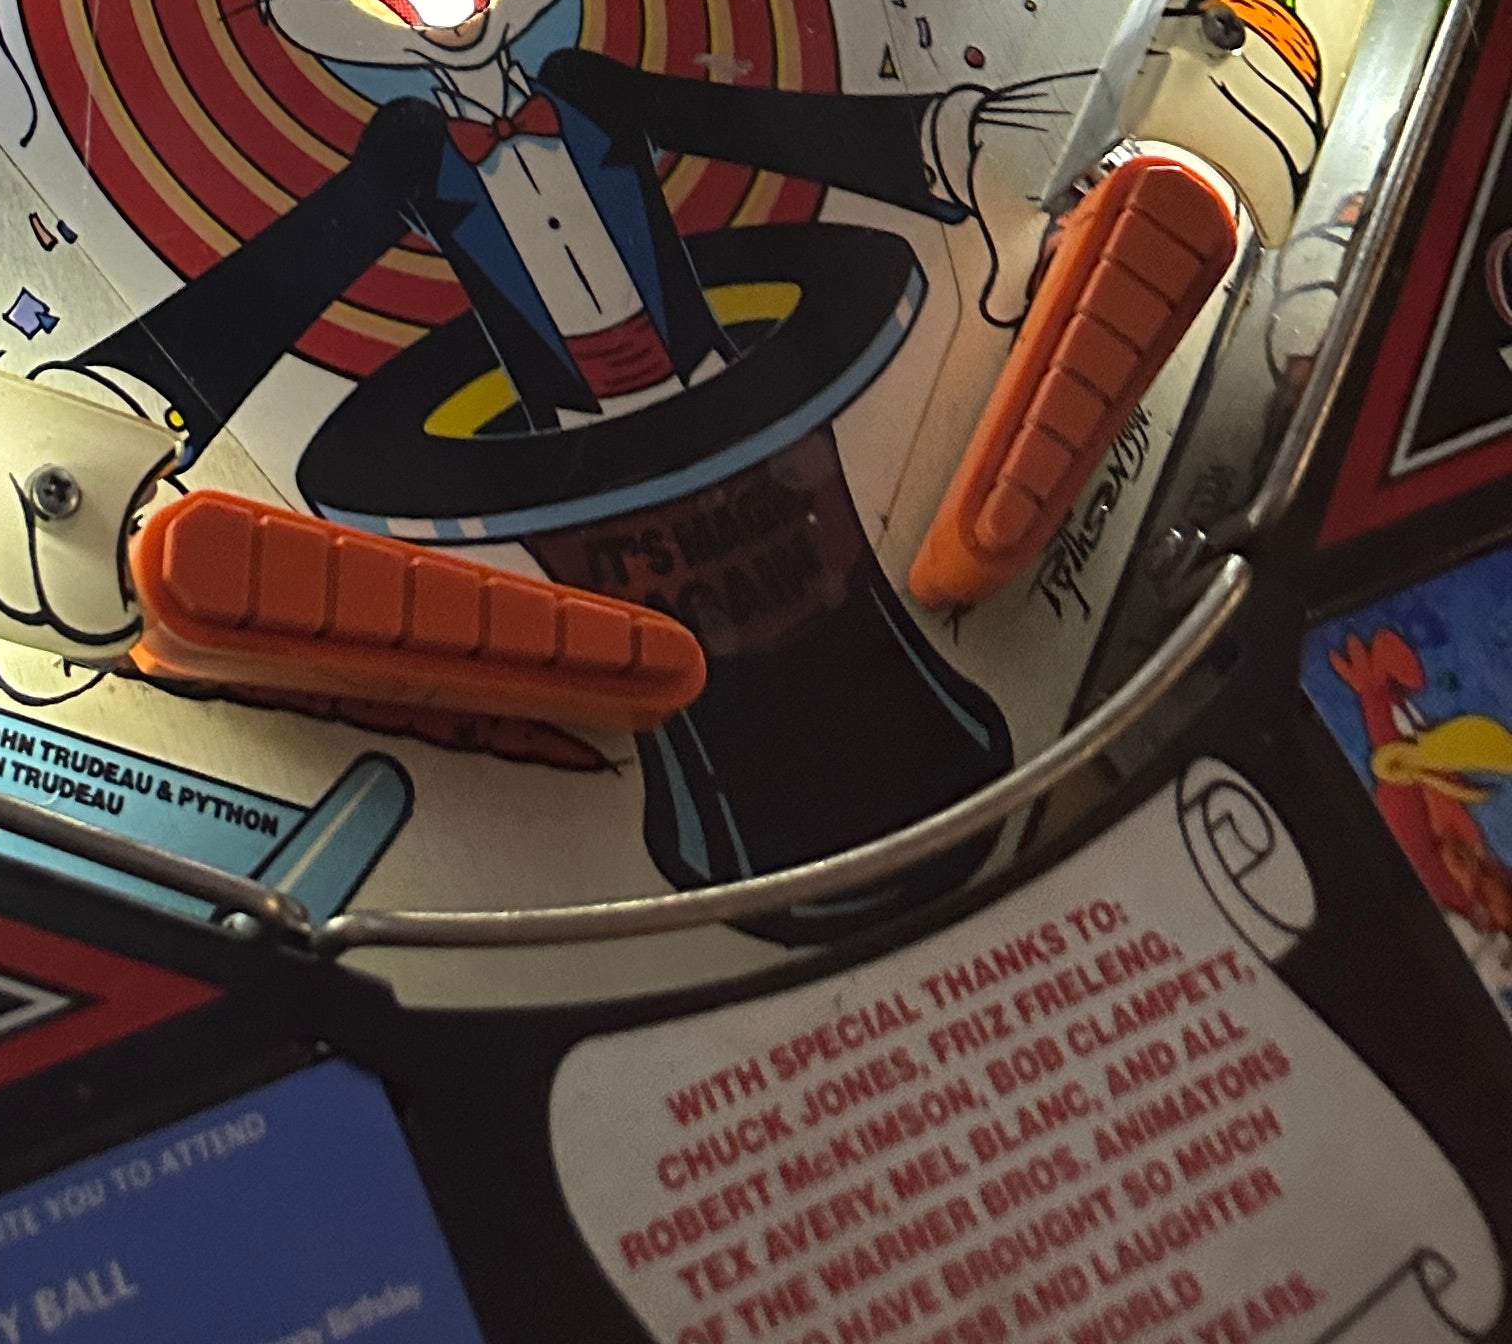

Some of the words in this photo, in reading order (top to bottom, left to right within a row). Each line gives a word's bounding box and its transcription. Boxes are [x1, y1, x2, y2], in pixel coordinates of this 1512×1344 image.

[11, 761, 125, 816] TRUDEAU
[41, 740, 154, 794] TRUDEAU
[156, 780, 172, 802] &
[178, 786, 279, 837] PYTHON
[656, 1104, 793, 1192] CHUCK
[801, 1046, 931, 1127] JONES,
[928, 1003, 1015, 1064] FRIZ
[665, 1057, 768, 1127] WITH
[769, 990, 924, 1082] SPECIAL
[920, 922, 1068, 1010] THANKS
[1064, 898, 1130, 944] TO:
[43, 1178, 107, 1221] YOU
[110, 1157, 154, 1192] TO
[158, 1110, 268, 1176] ATTEND
[619, 1168, 771, 1270] ROBERT
[985, 1035, 1065, 1096] BOB
[1065, 946, 1257, 1058] CLAMPETT,
[676, 1239, 758, 1302] TEX
[890, 1144, 972, 1202] MEL
[1105, 1039, 1177, 1099] AND
[1181, 1010, 1250, 1062] ALL
[734, 1272, 820, 1337] THE
[817, 1196, 978, 1298] WARNER
[1092, 1040, 1291, 1163] ANIMATORS
[941, 1185, 1117, 1301] BROUGHT
[1121, 1158, 1175, 1209] SO
[1173, 1103, 1283, 1182] MUCH
[32, 1258, 140, 1334] BALL
[1011, 1262, 1091, 1330] AND
[1087, 1164, 1285, 1287] LAUGHTER
